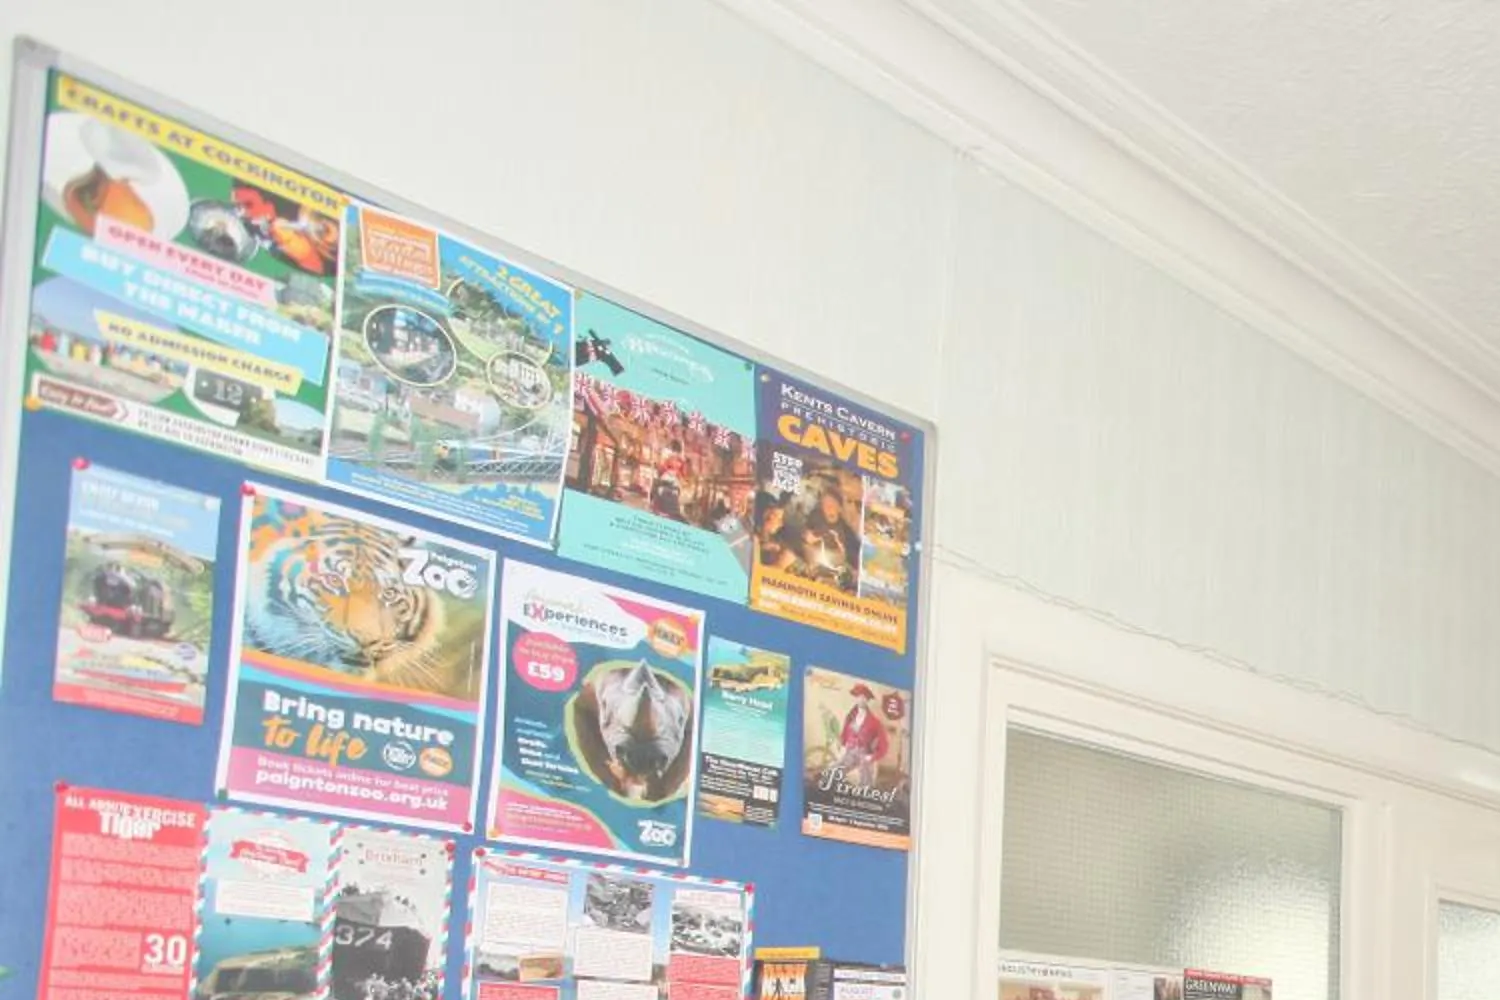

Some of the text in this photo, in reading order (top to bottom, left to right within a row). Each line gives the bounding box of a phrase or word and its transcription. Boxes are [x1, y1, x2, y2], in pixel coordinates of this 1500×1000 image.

[65, 85, 341, 212] CRAFTS AT COCKINGTON
[80, 242, 138, 279] BUY
[106, 224, 269, 293] OPEN EVERY DAY
[121, 281, 171, 316] THE
[106, 322, 294, 385] NO ADMISSION CHARGE
[780, 383, 896, 441] KENTS CAVERN
[777, 414, 898, 479] CAVES
[527, 661, 566, 683] £59
[262, 715, 368, 767] to life
[353, 712, 455, 745] nature
[255, 769, 449, 811] paigntonzoo.org.uk
[143, 933, 188, 967] 30
[335, 924, 394, 950] 374
